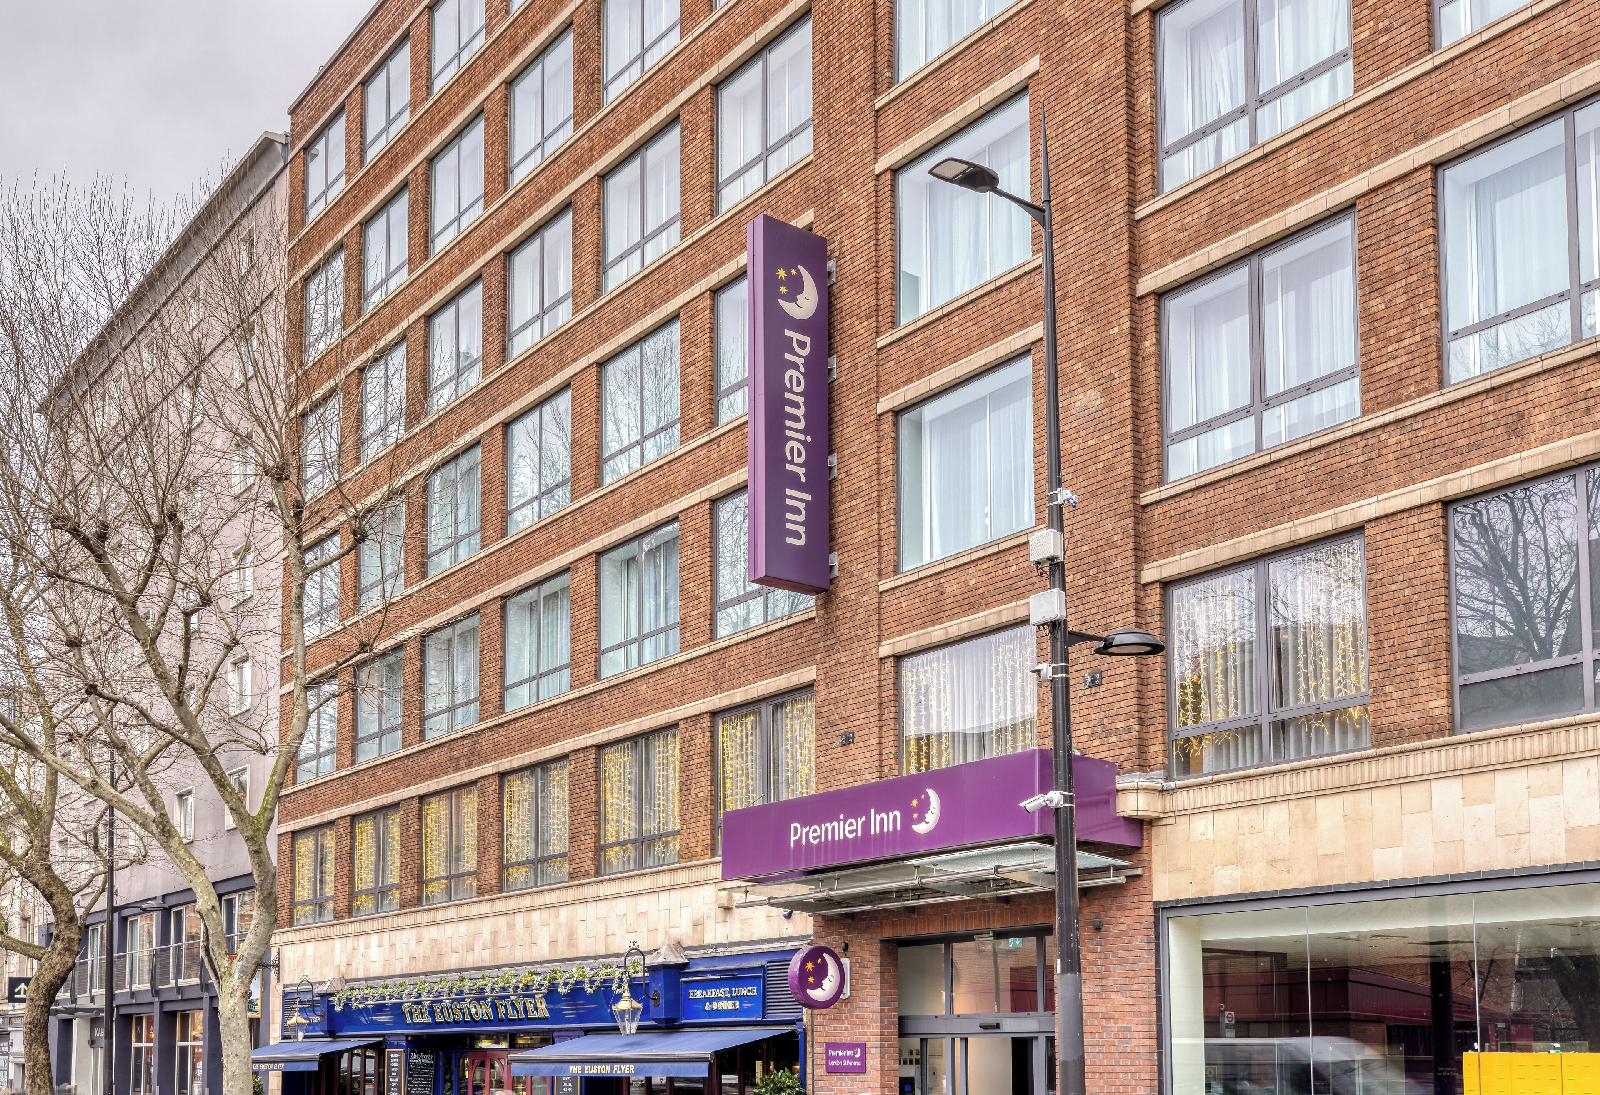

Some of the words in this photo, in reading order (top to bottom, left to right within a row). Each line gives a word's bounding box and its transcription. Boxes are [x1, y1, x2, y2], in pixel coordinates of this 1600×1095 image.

[784, 328, 812, 483] Premier
[784, 488, 812, 546] Inn
[790, 813, 866, 848] Premier
[870, 808, 901, 835] Inn
[402, 1002, 432, 1024] THE
[432, 999, 494, 1022] EUSTON
[495, 994, 550, 1020] FLYER
[569, 1064, 582, 1074] THE
[584, 1064, 611, 1074] EUSTON
[612, 1064, 635, 1074] FLYER
